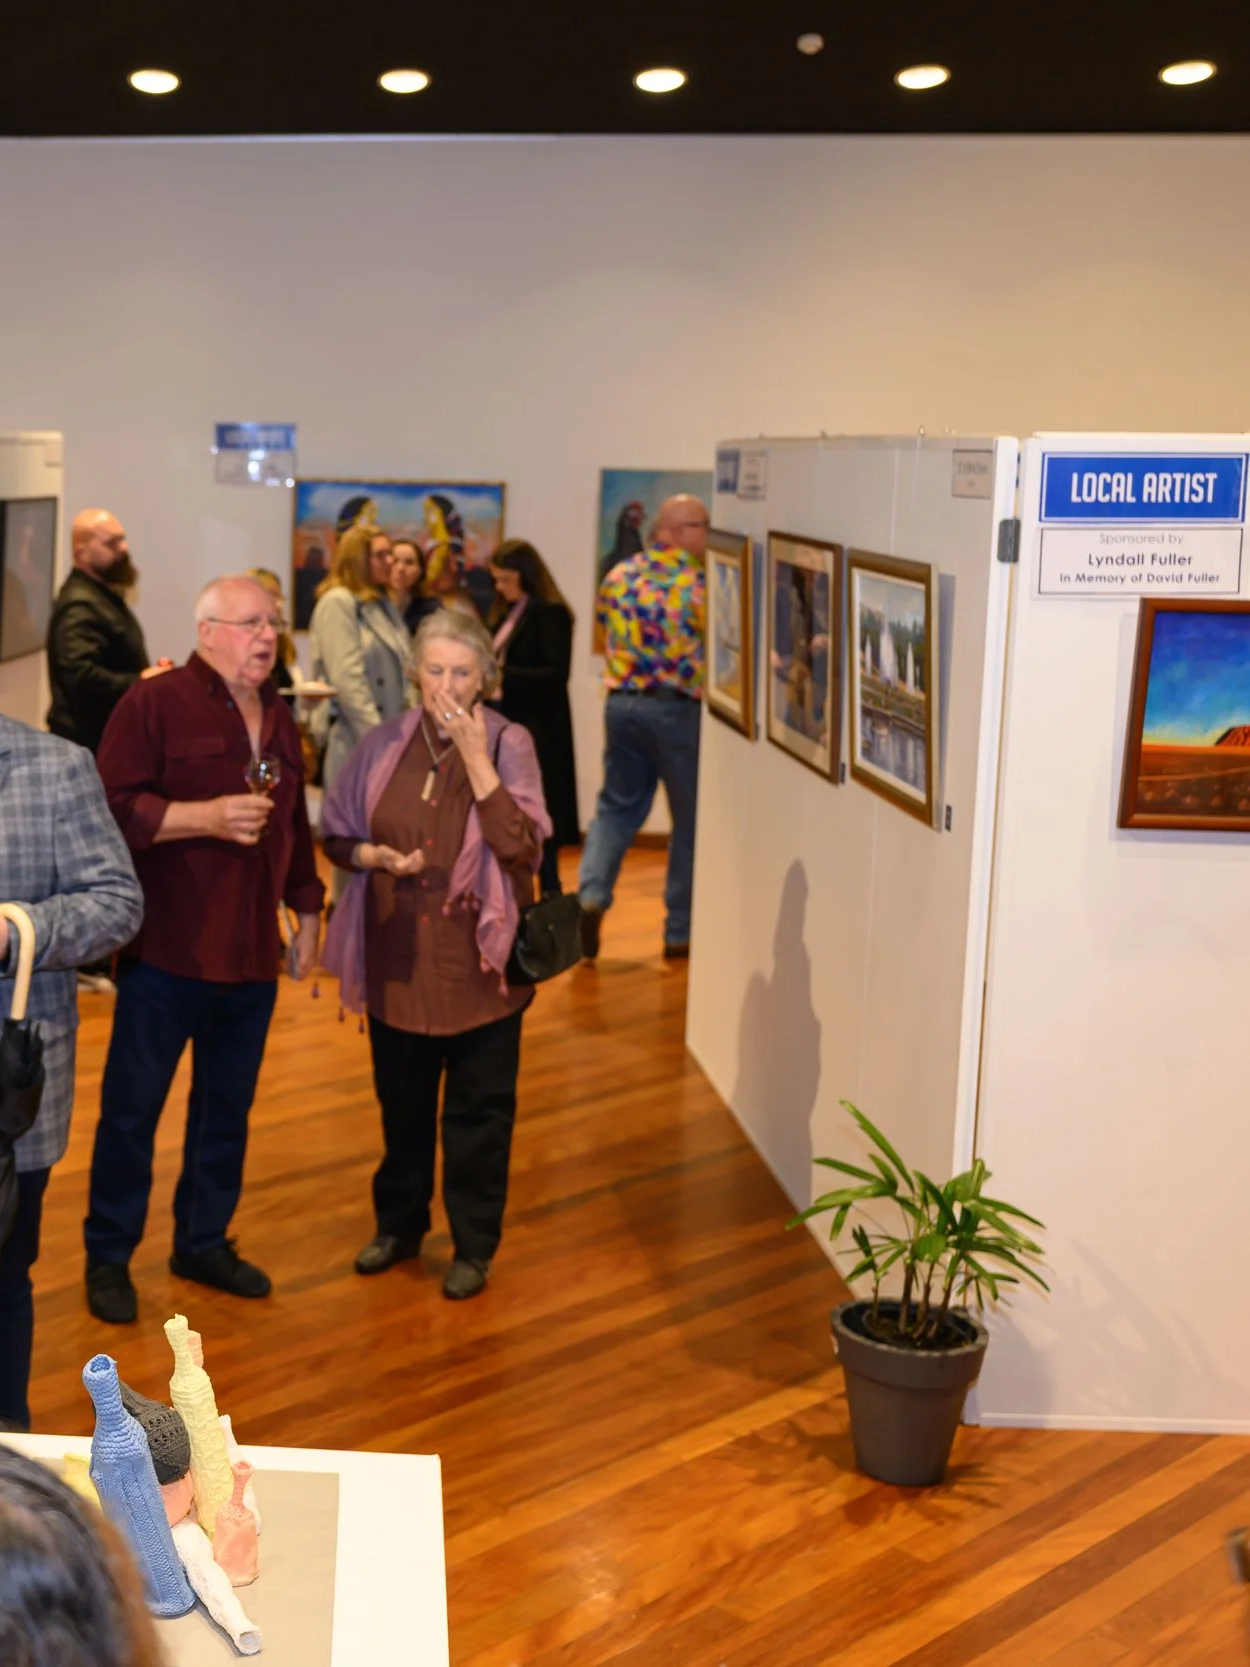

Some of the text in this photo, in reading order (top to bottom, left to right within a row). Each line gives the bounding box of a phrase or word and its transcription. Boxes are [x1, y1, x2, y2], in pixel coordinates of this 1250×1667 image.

[1071, 472, 1218, 504] LOCAL ARTIST
[1099, 532, 1184, 546] Sponsored by
[1088, 552, 1194, 569] Lyndall Fuller
[1059, 572, 1221, 586] In Memory of David Fuller
